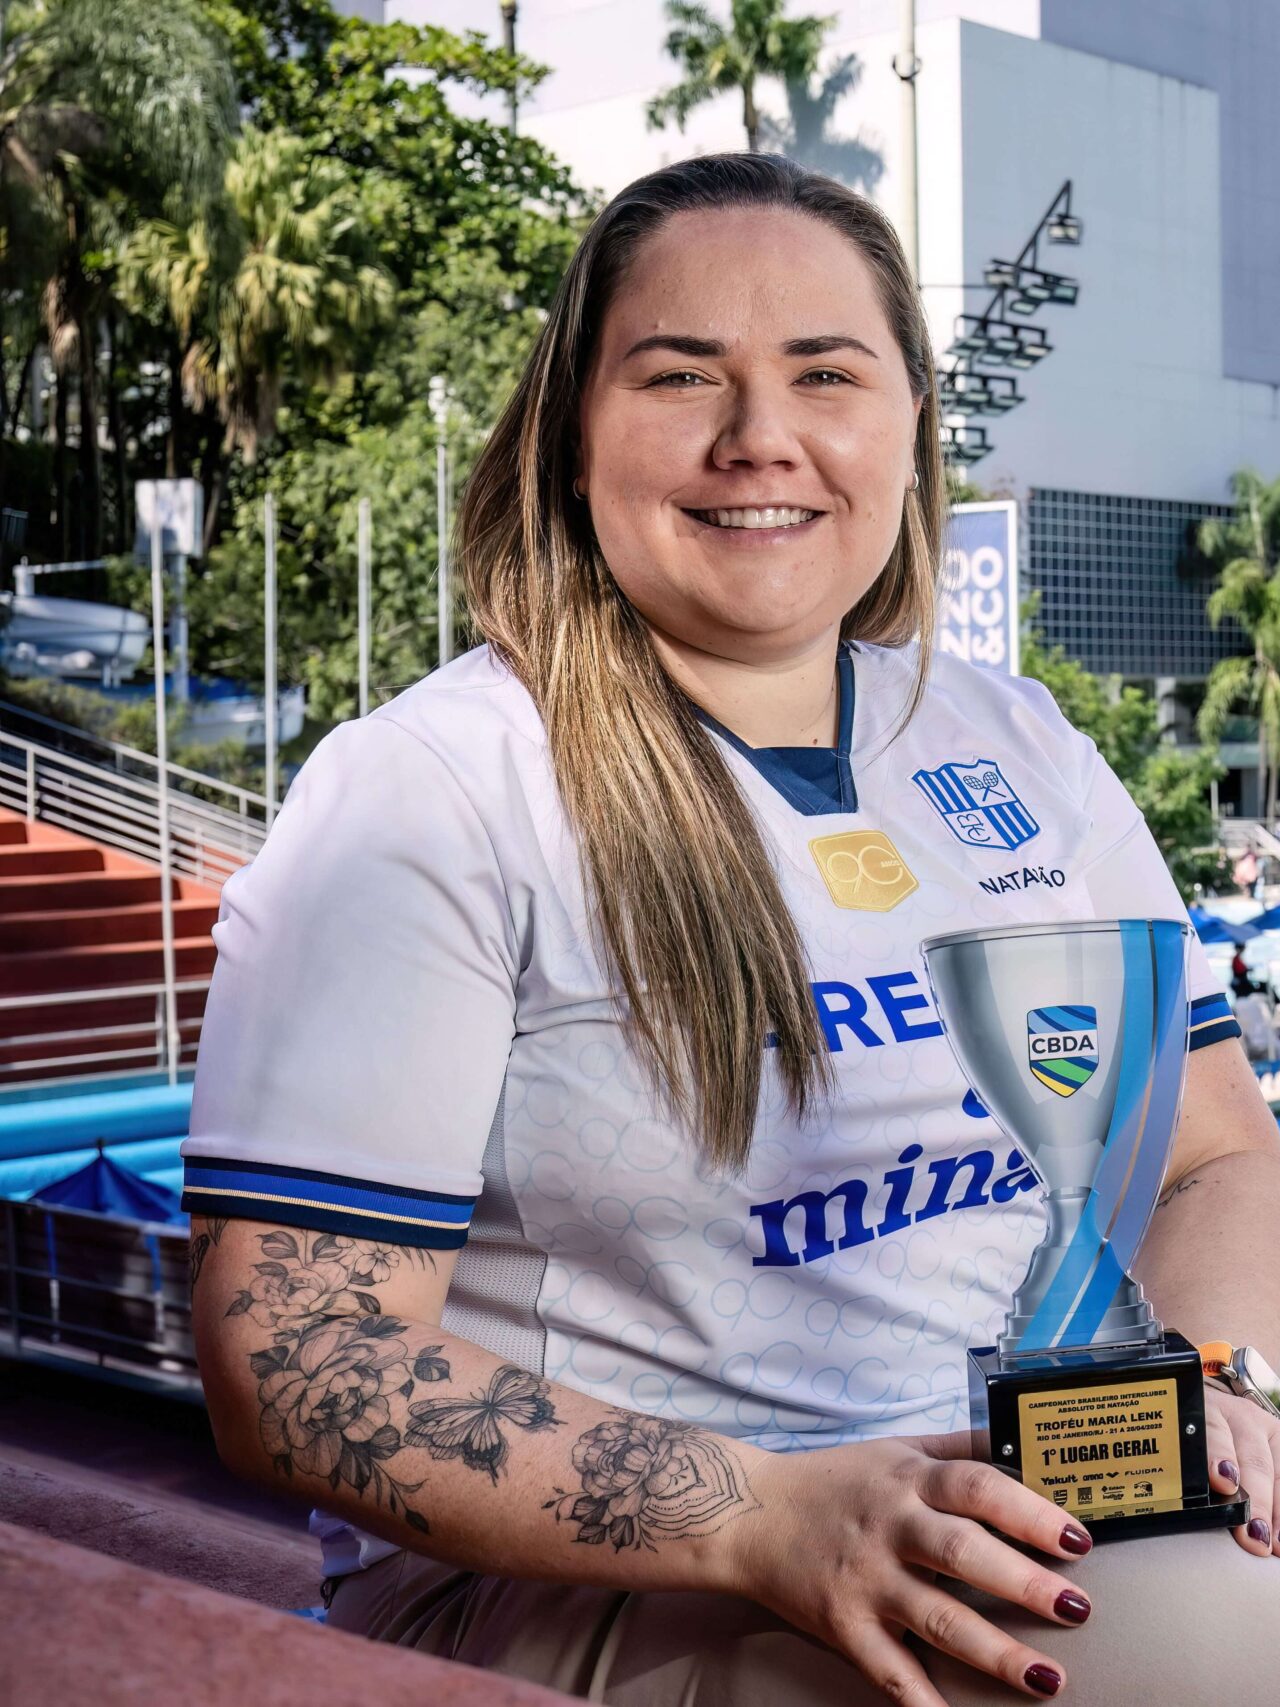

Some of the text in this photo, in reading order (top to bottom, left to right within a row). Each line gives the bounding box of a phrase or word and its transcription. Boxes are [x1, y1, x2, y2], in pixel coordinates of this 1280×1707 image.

[970, 545, 1006, 666] &CO
[978, 866, 1066, 895] NATAÃO
[1031, 1034, 1095, 1054] CBDA
[1028, 1390, 1168, 1409] CAMPEONATO BRASILEIRO INTERCLUBES
[1058, 1405, 1095, 1414] ABSOLUTO
[1107, 1399, 1140, 1408] NATAÇÃO
[1035, 1410, 1164, 1432] TROFÉU MARIA LENK
[1037, 1434, 1050, 1442] RIO
[1062, 1429, 1104, 1439] JANEIRO/RJ
[1109, 1427, 1118, 1435] 21
[1060, 1443, 1109, 1465] LUGAR
[1112, 1438, 1160, 1459] GERAL
[1040, 1467, 1164, 1486] Yakult arena FLUIDRA
